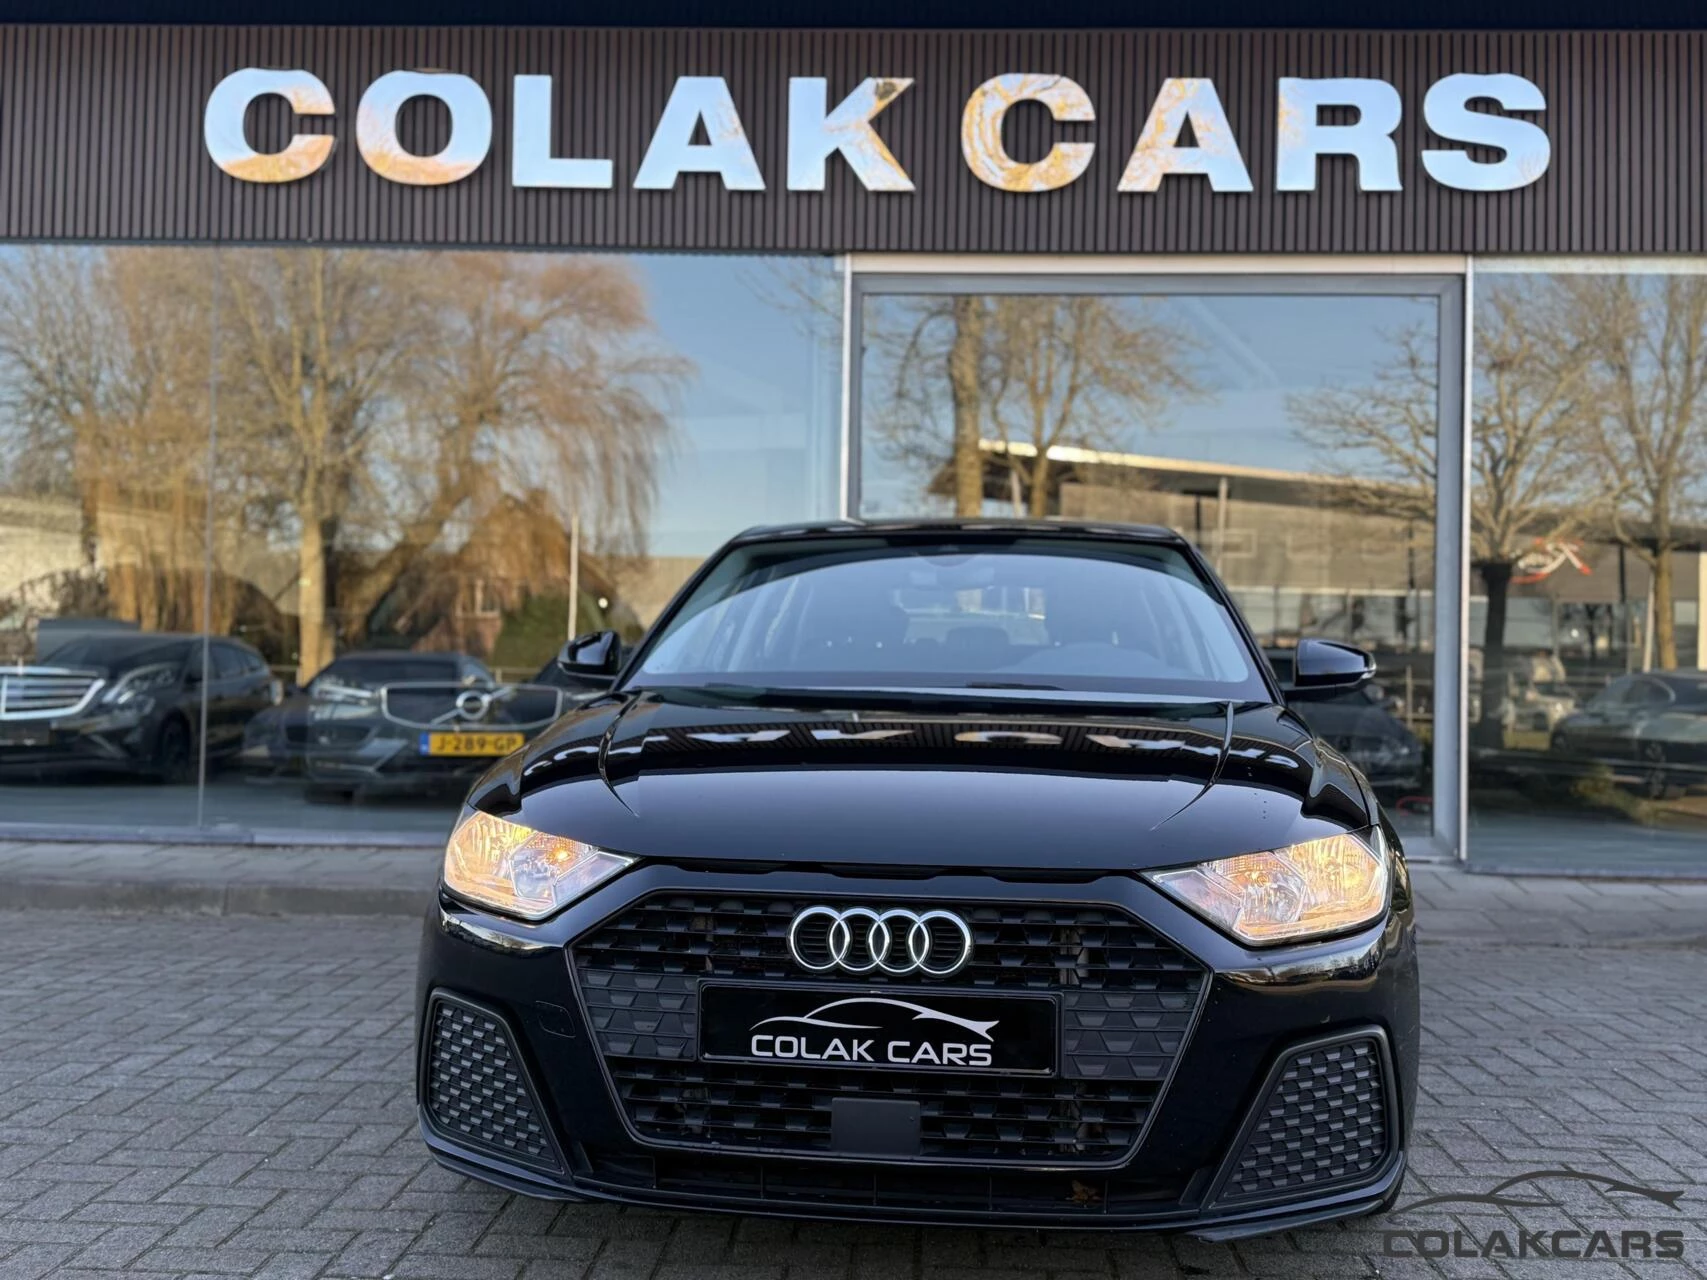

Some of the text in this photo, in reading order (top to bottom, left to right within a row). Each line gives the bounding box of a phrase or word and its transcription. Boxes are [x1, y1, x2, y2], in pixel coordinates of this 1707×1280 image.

[203, 67, 1552, 193] COLAK CARS
[751, 1034, 993, 1067] COLAK CARS
